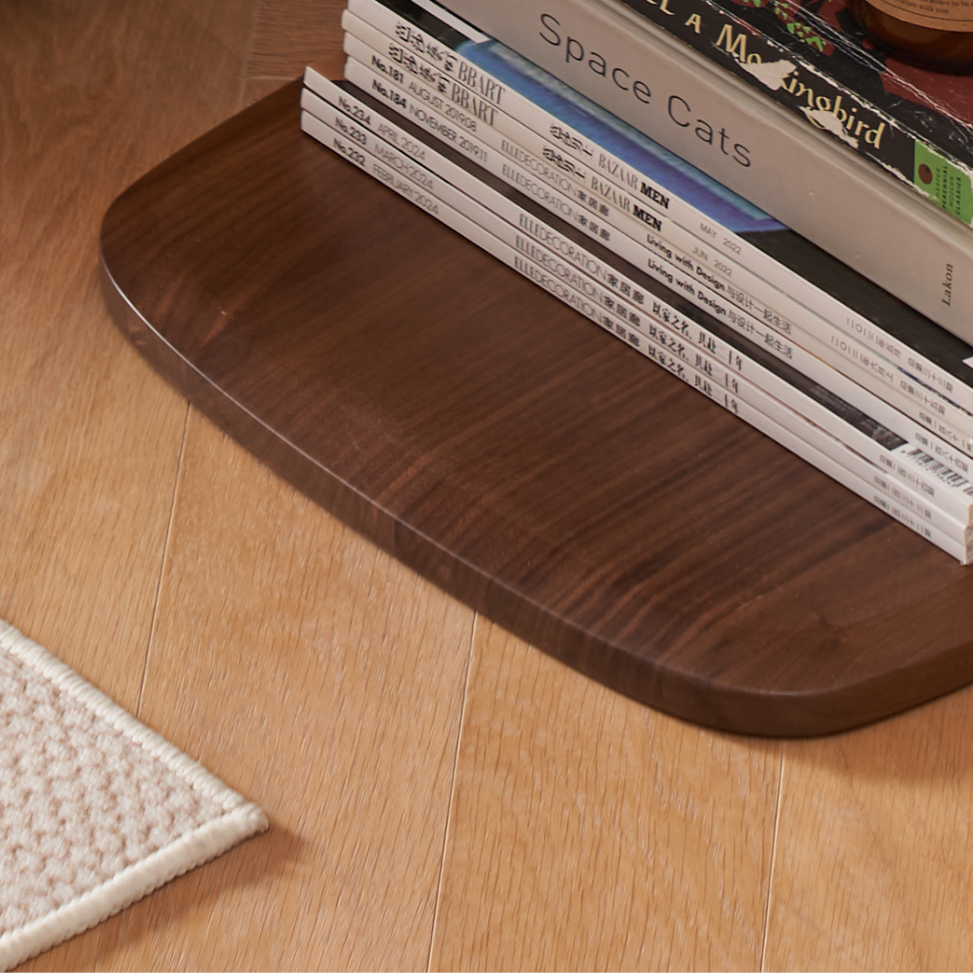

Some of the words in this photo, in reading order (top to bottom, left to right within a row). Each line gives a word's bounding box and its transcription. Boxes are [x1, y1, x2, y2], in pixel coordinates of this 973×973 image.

[371, 55, 405, 85] No.181
[408, 80, 444, 114] AUGUST
[372, 79, 408, 110] No.184
[409, 104, 458, 144] NOVEMBER
[539, 13, 652, 105] Space
[667, 95, 752, 169] Cats
[685, 13, 702, 35] A
[716, 24, 885, 149] Moingbird
[334, 116, 368, 146] No.233
[407, 164, 434, 190] 2024
[338, 96, 372, 126] No.234
[401, 139, 427, 162] 2024
[333, 137, 367, 167] No.232
[412, 188, 440, 212] 2024
[598, 153, 640, 192] BAZAAR
[640, 181, 670, 210] MEN
[700, 223, 718, 239] MAY
[722, 237, 743, 256] 2022
[590, 175, 632, 215] BAZAAR
[632, 204, 663, 233] MEN
[691, 246, 708, 262] JUN
[713, 260, 733, 278] 2022
[646, 233, 672, 261] Living
[674, 252, 694, 272] with
[696, 265, 726, 292] Design
[647, 258, 673, 284] Living
[675, 277, 695, 297] with
[697, 289, 727, 317] Design
[941, 263, 954, 307] Lakon
